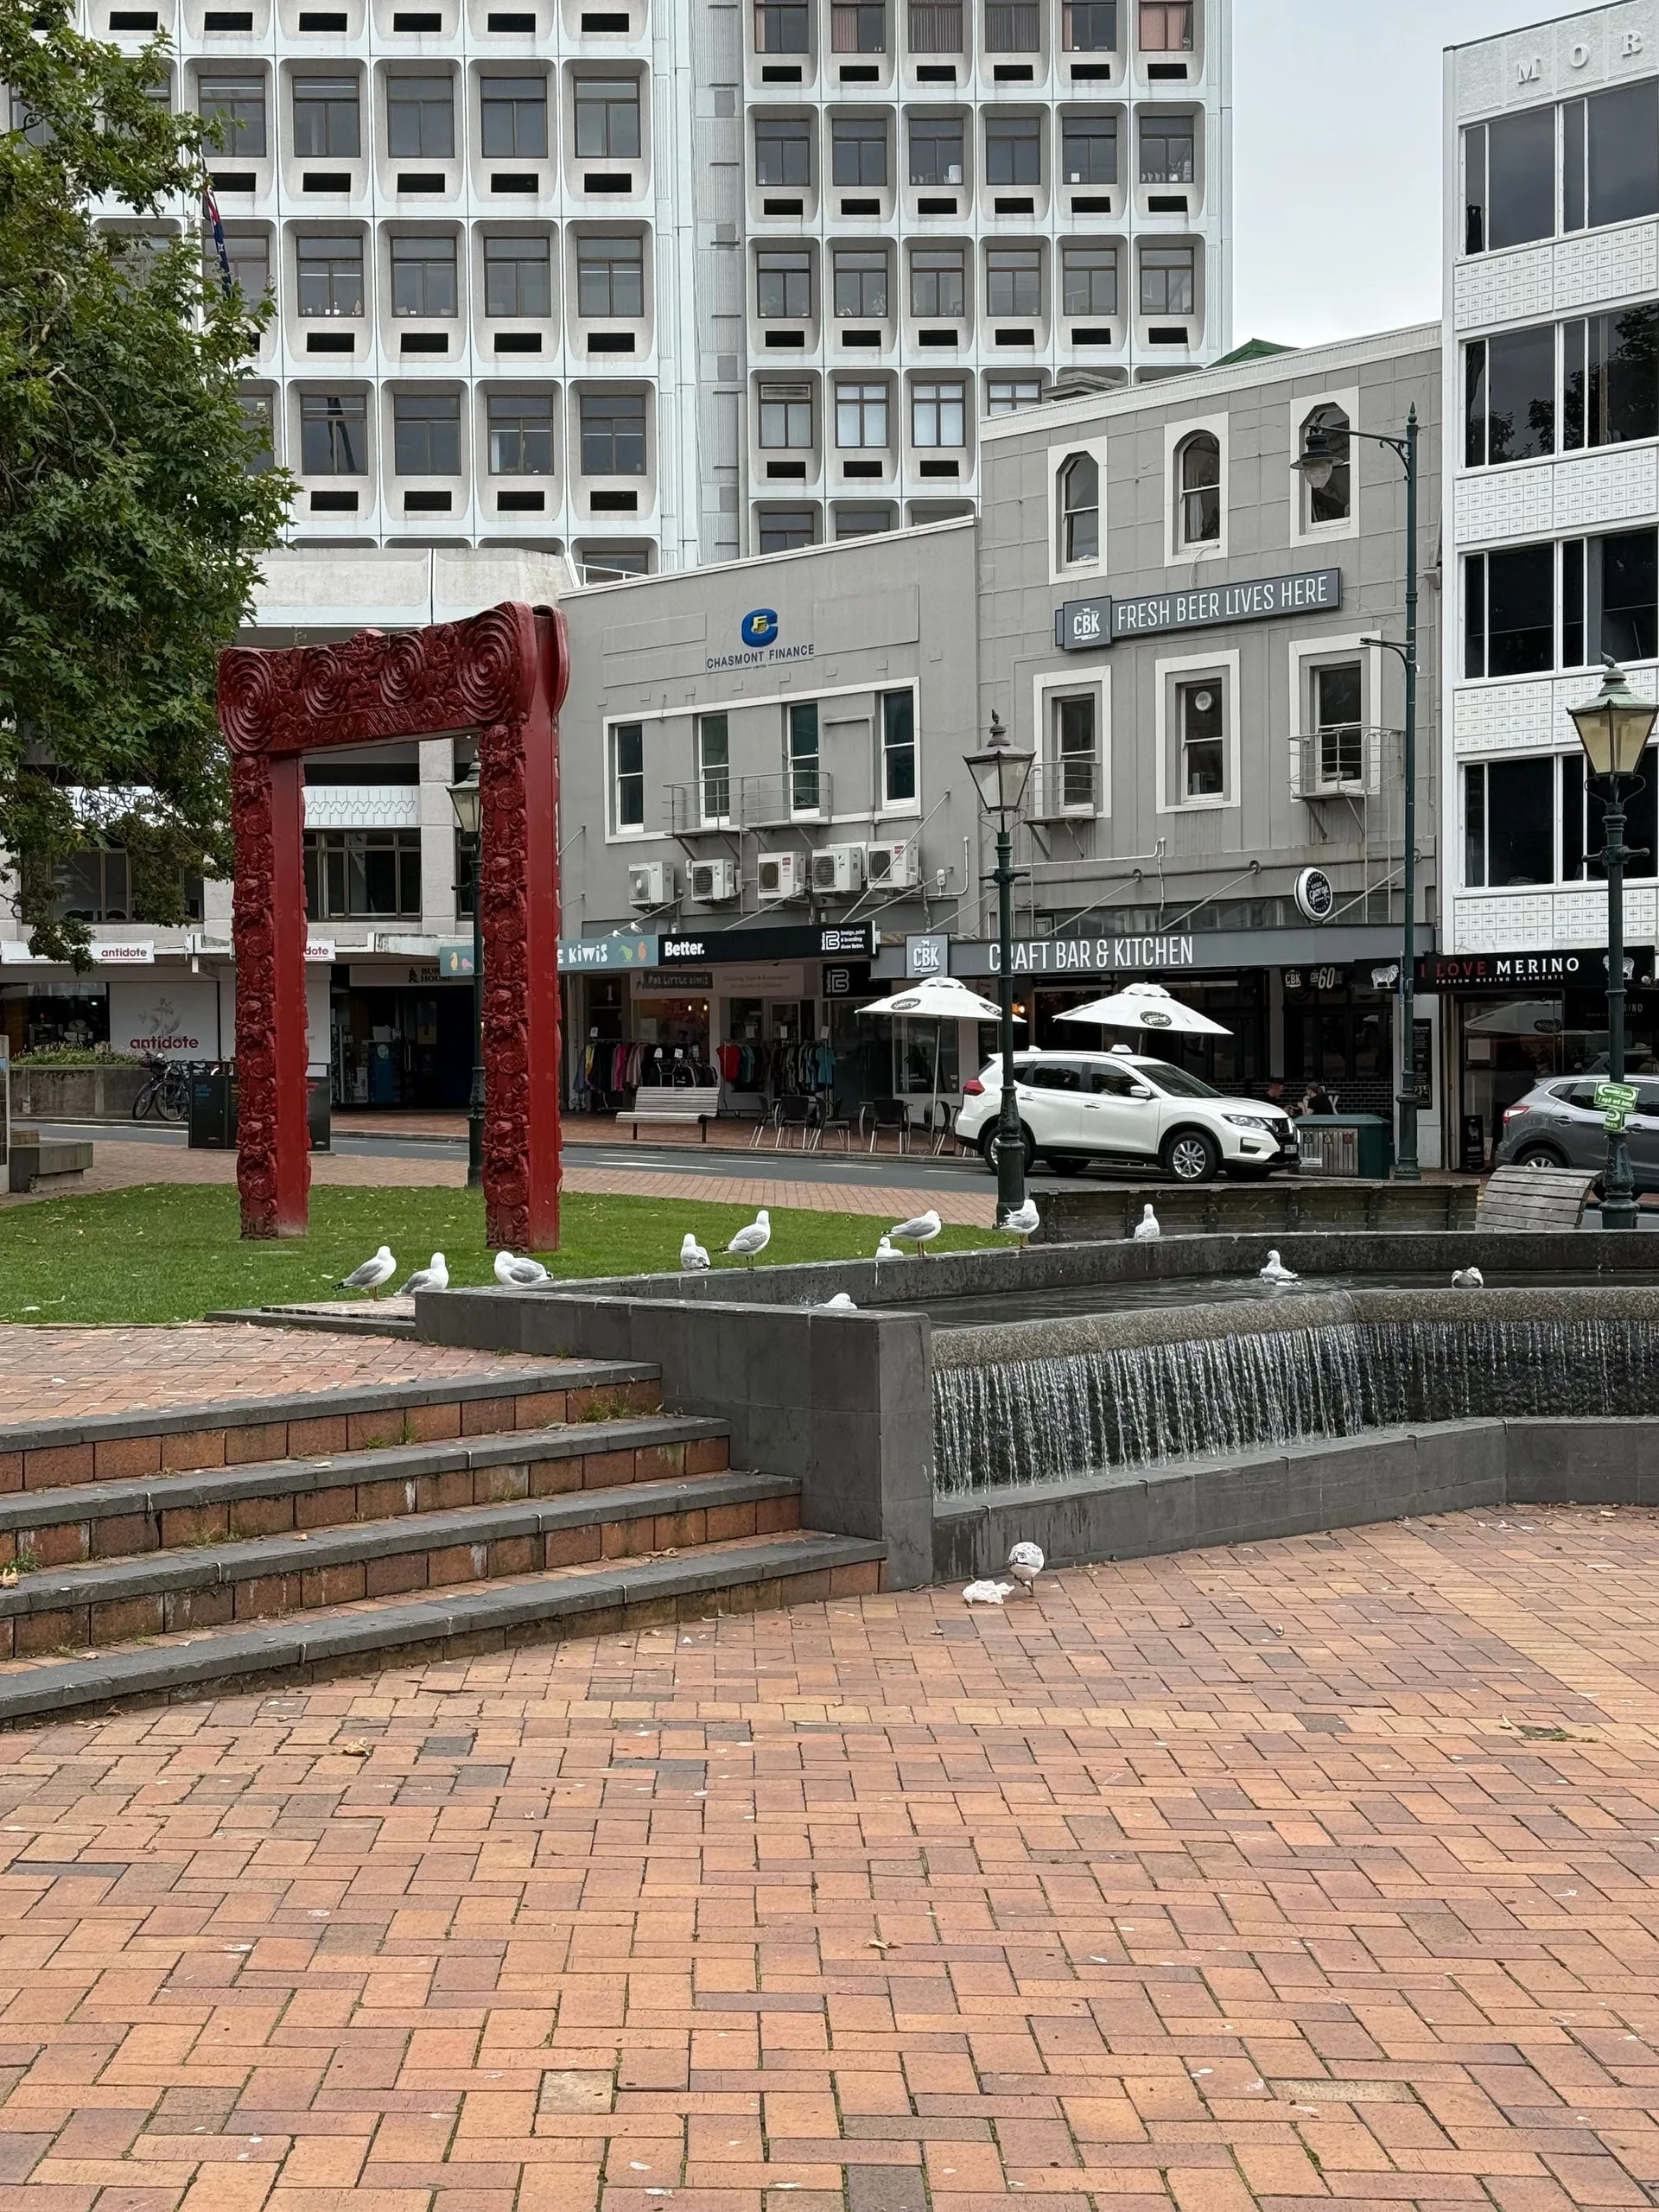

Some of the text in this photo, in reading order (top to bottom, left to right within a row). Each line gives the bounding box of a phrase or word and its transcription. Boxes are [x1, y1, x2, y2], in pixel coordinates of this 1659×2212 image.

[1118, 576, 1327, 630] FRESH BEER LIVES HERE
[1073, 613, 1101, 635] CBK
[707, 644, 814, 669] CHASMONT FINANCE
[101, 947, 147, 957] antidote
[664, 941, 705, 957] Better.
[913, 946, 940, 968] CBK
[1056, 940, 1091, 969] BAR
[1096, 939, 1109, 968] &
[1115, 936, 1193, 966] KITCHEN
[1286, 973, 1301, 984] CBK
[1318, 967, 1335, 989] 60
[1420, 957, 1580, 978] I LOVE MERINO
[130, 1035, 200, 1050] antidote
